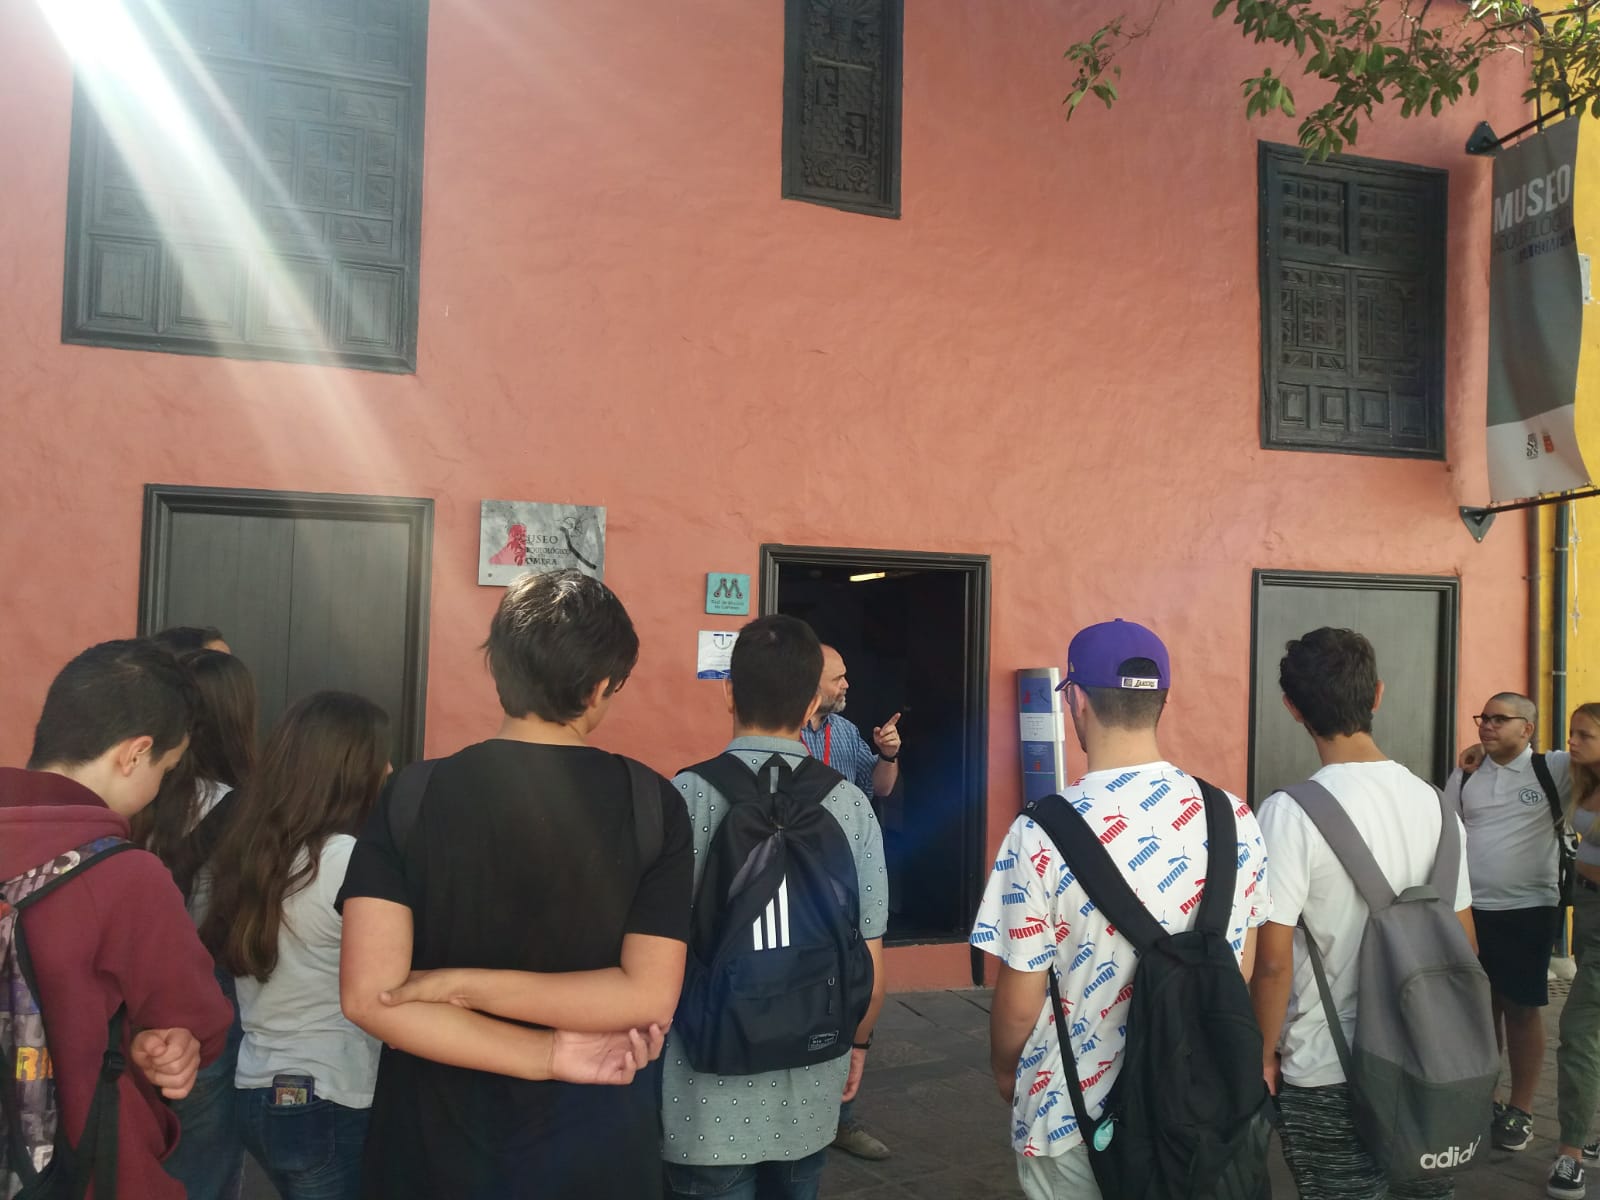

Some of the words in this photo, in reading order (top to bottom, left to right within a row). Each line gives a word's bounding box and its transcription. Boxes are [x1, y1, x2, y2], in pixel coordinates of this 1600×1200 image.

[1493, 164, 1571, 235] MUSEO
[1139, 783, 1171, 812] PUMA
[1171, 801, 1203, 831] PUMA
[1127, 840, 1160, 872] PUMA
[1156, 860, 1189, 893] PUMA
[1008, 923, 1044, 940] PUMA
[1420, 1134, 1481, 1170] adid
